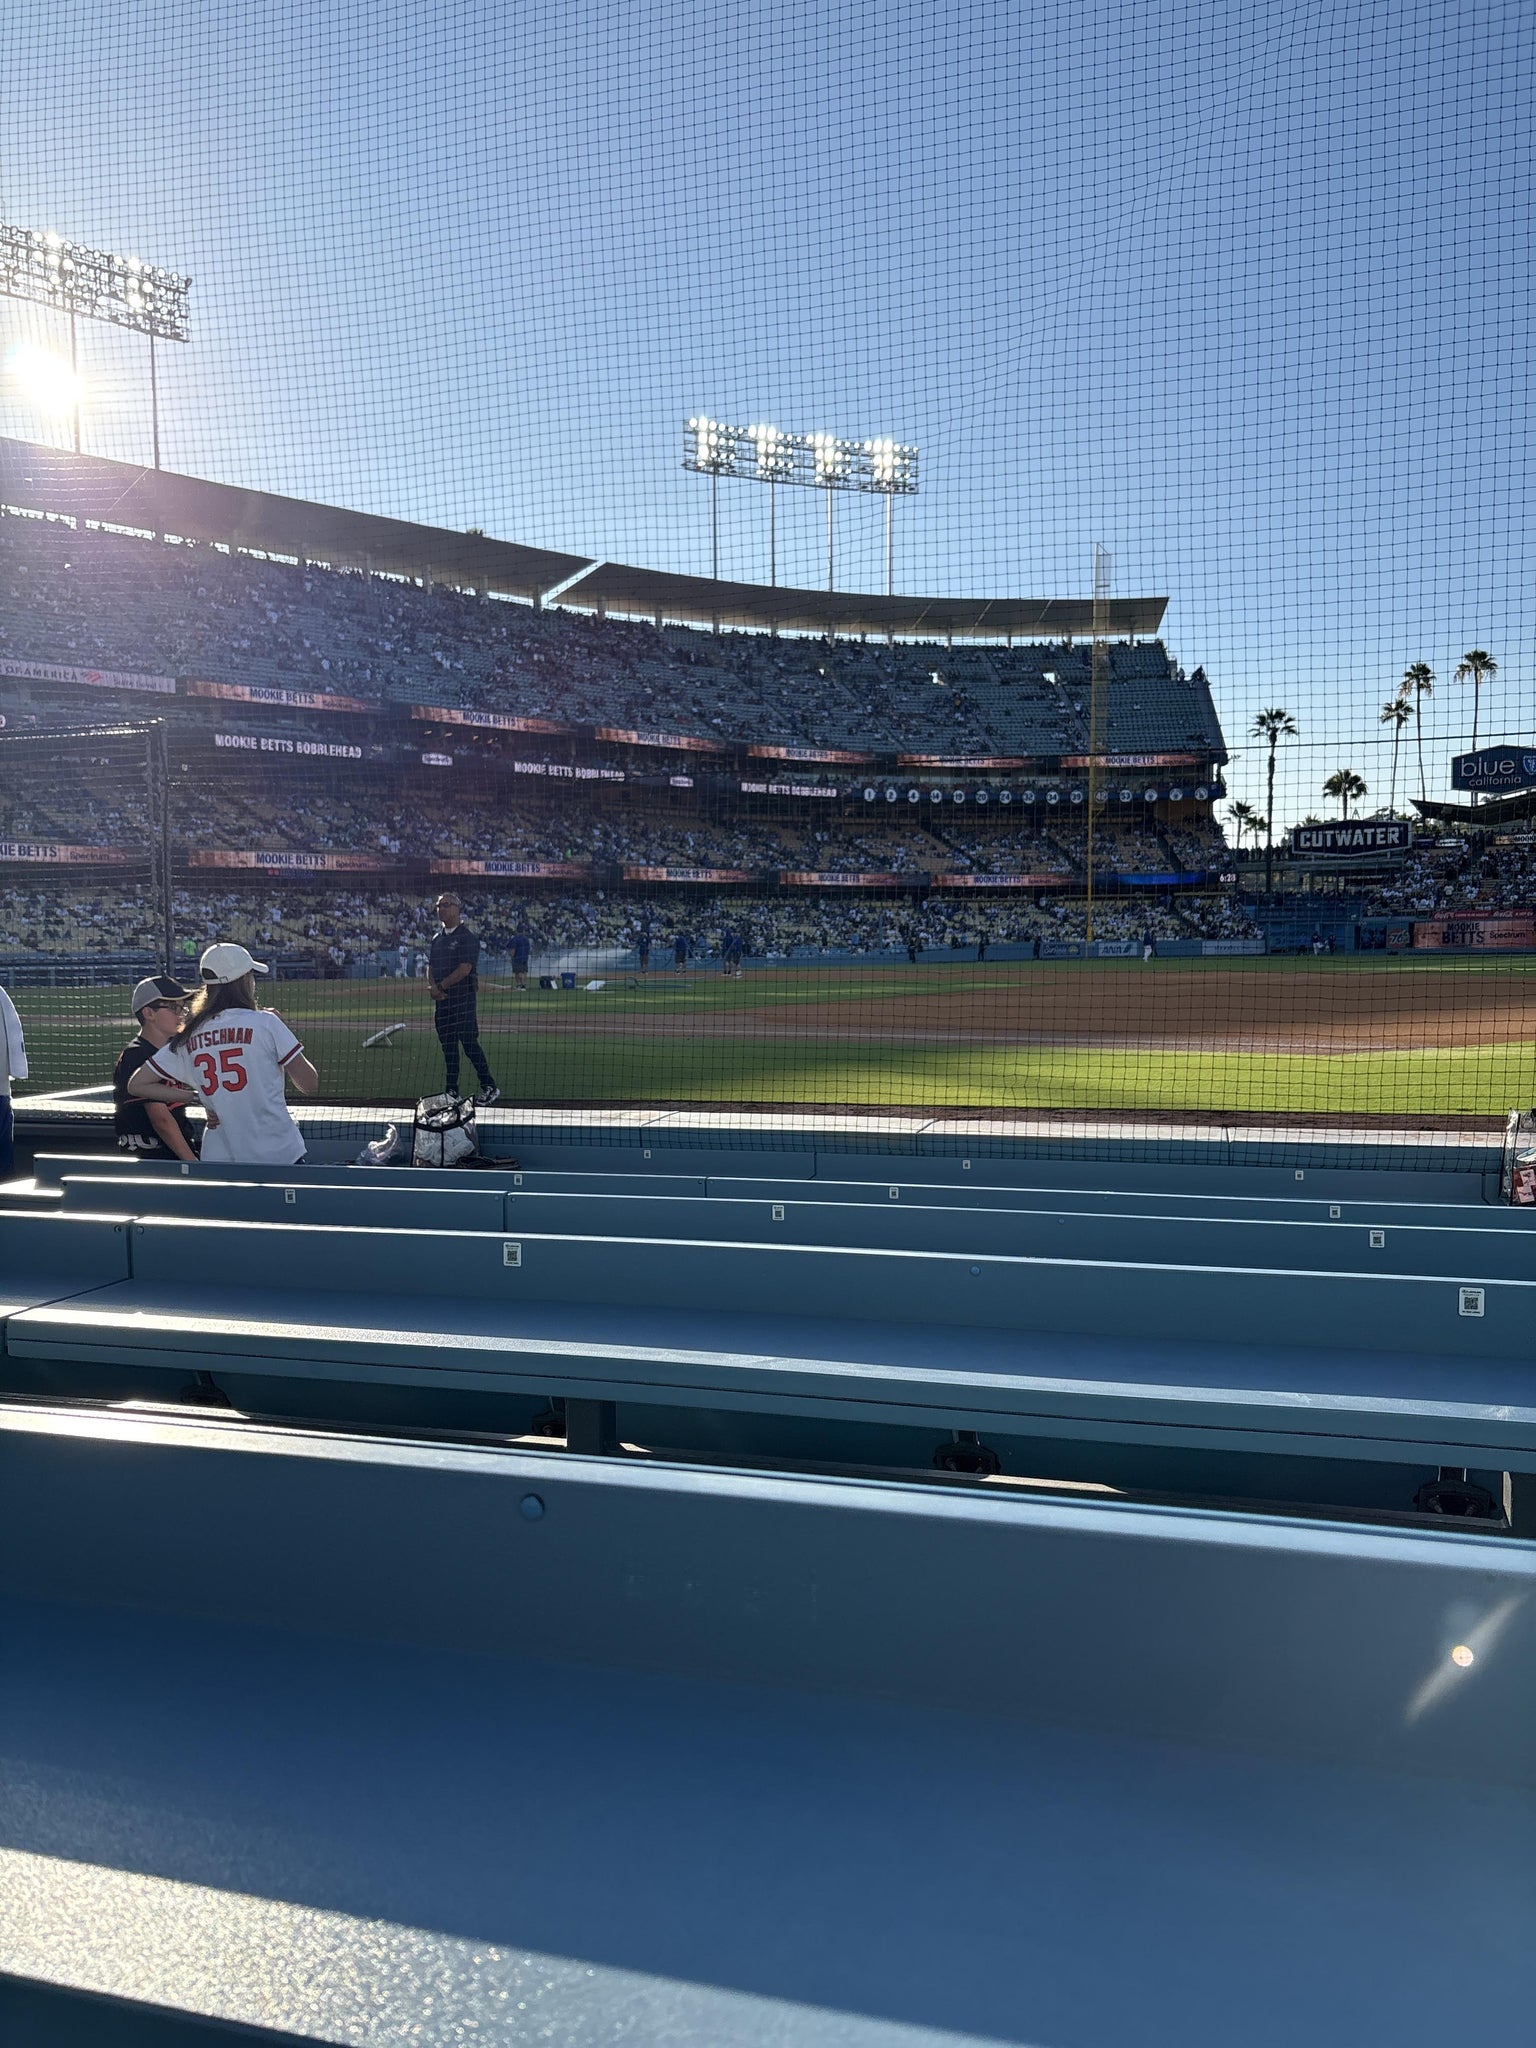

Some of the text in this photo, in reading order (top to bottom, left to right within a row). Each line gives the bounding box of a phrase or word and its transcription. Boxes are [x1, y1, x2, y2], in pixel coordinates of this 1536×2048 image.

[250, 688, 315, 705] MOOKIE BETTS
[463, 711, 491, 724] MOOKIE
[215, 734, 362, 759] MOOKIE BETTS BOBBLEHEAD
[1105, 756, 1155, 765] MOOKIE BETTS
[1460, 757, 1515, 777] blue
[514, 761, 546, 775] MOOKIE
[548, 764, 573, 778] BETTS
[1468, 775, 1522, 787] california
[1300, 826, 1400, 848] CUTWATER
[18, 845, 57, 858] BETTS
[70, 851, 110, 861] Spectrum
[256, 853, 327, 866] MOOKIE BETTS
[484, 861, 515, 872] MOOKIE
[1447, 922, 1480, 931] MOOKIE
[1442, 931, 1526, 944] BETTS Spectrum
[185, 1027, 254, 1053] RUTSCHMAN
[194, 1047, 248, 1096] 35
